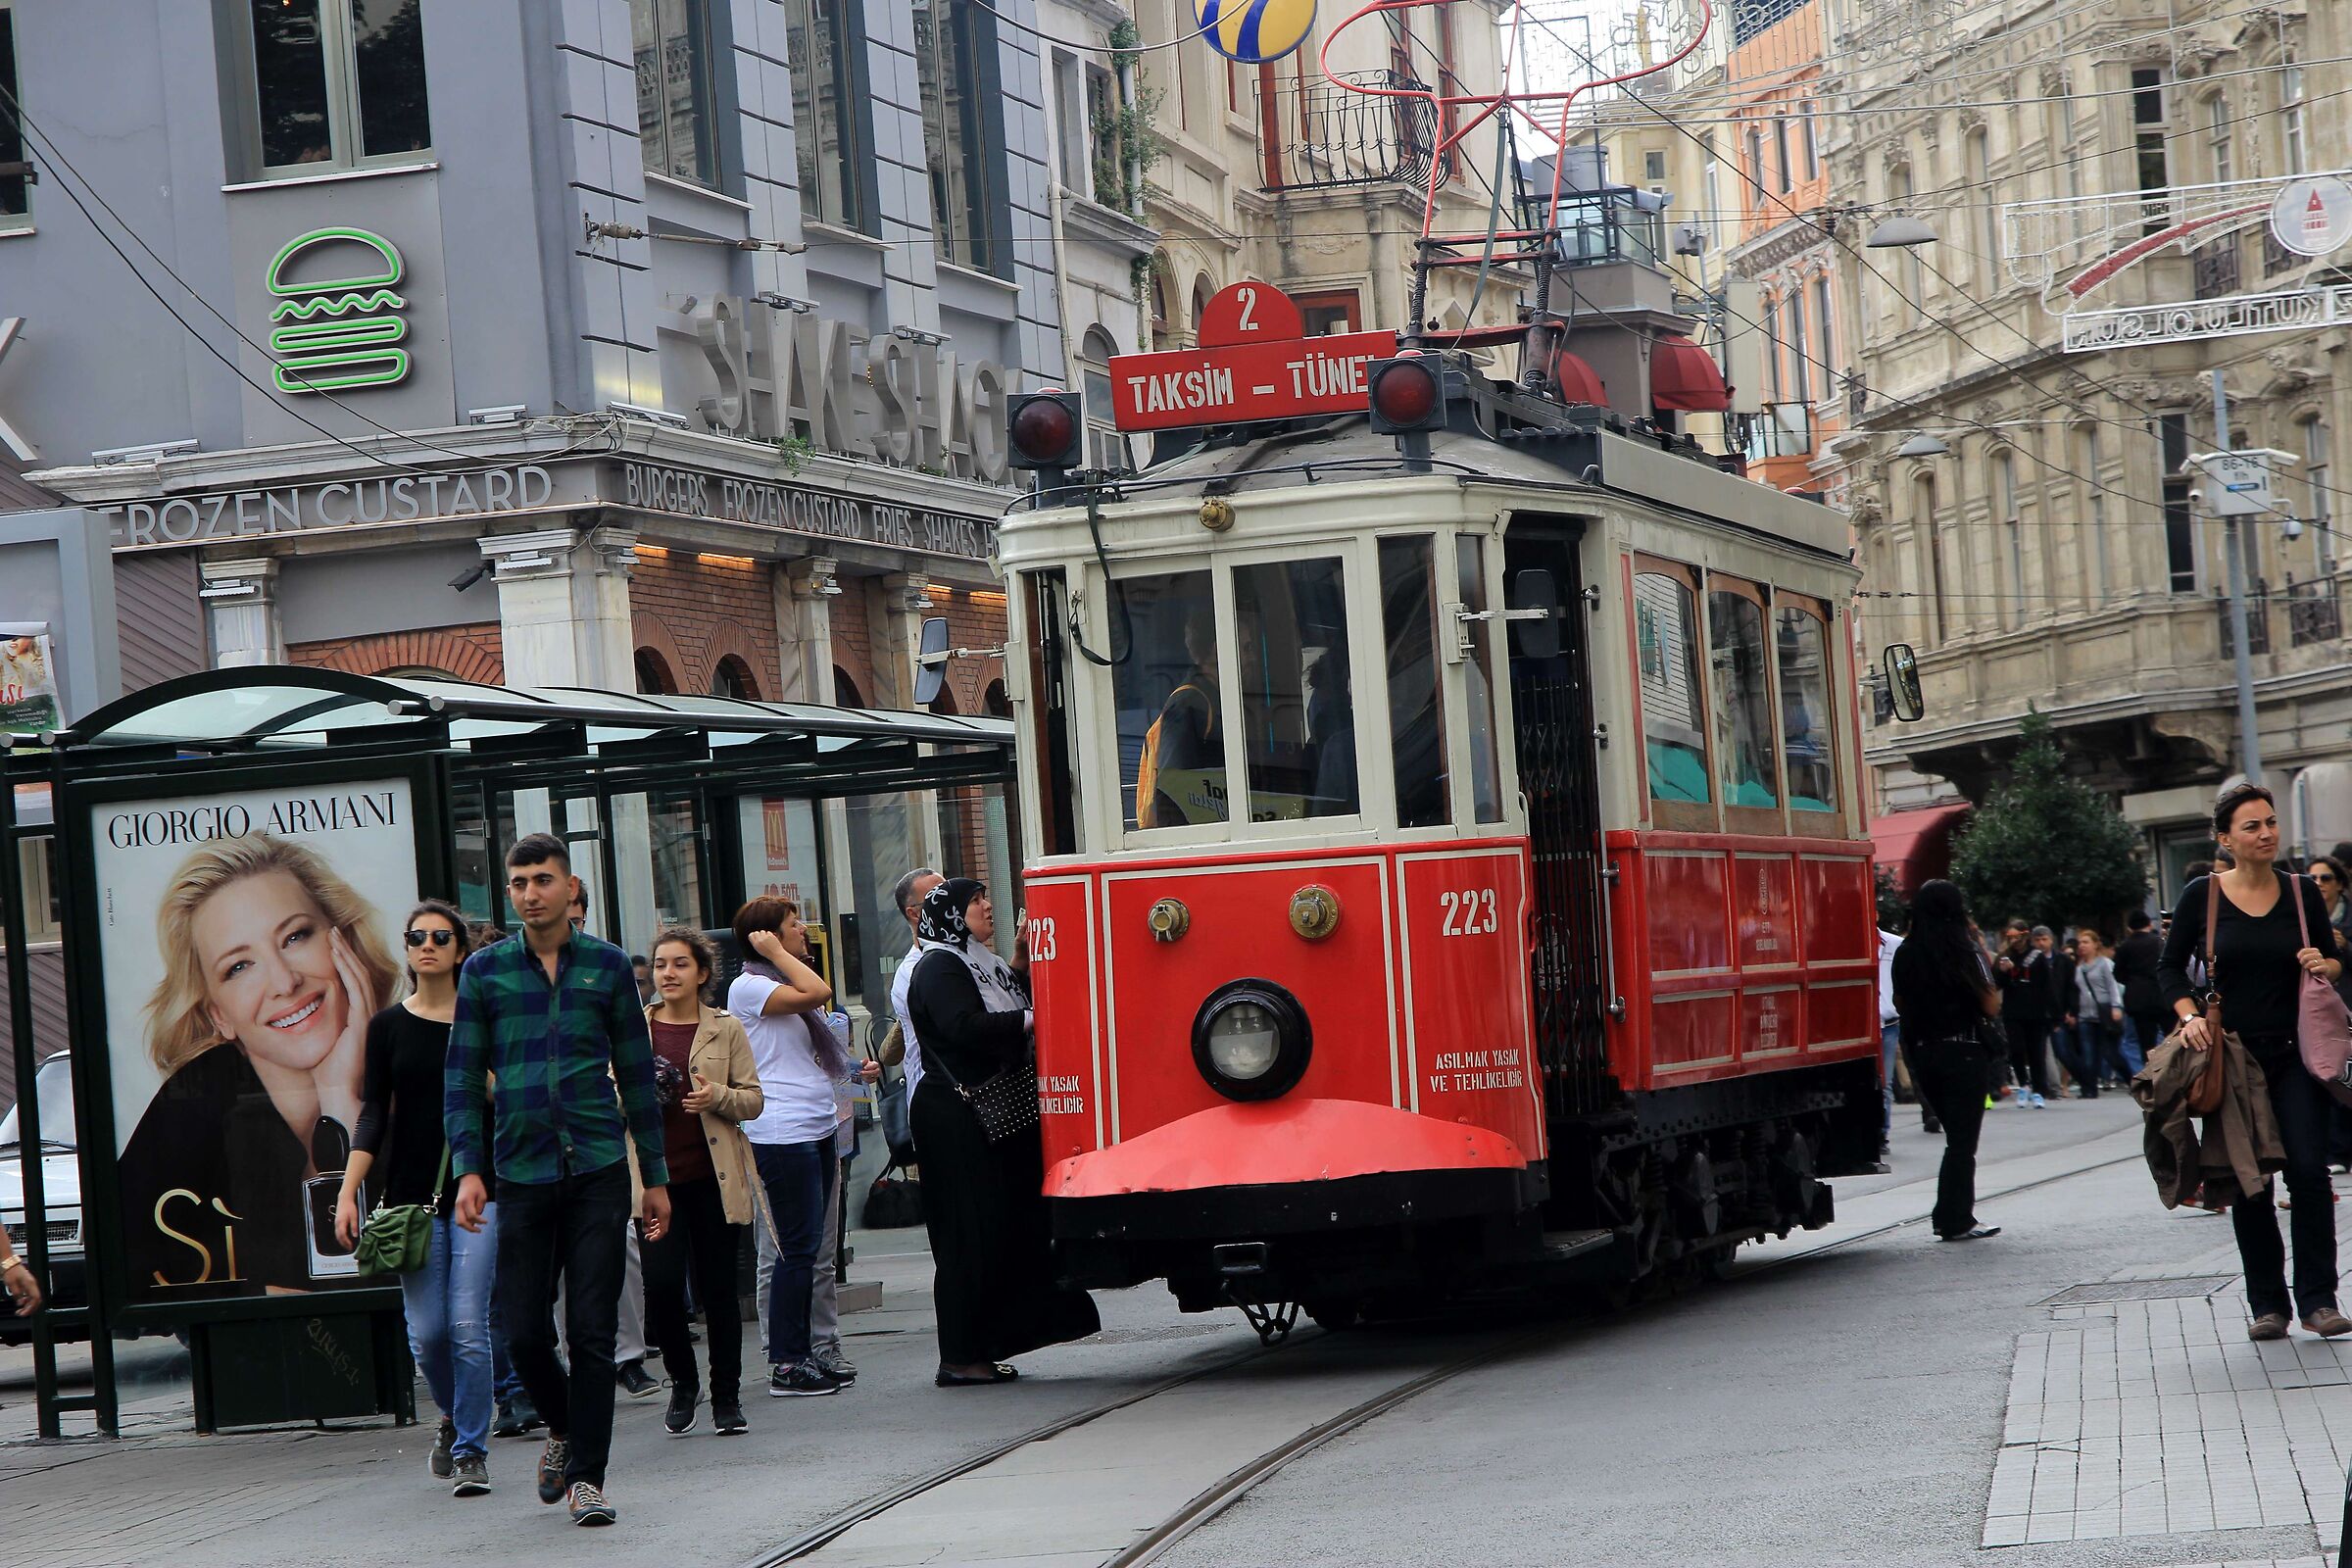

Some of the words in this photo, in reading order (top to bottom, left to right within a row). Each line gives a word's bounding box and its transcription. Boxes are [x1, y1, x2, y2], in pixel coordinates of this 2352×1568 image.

[1237, 287, 1259, 331] 2
[697, 293, 870, 459] SHAKE
[1127, 362, 1235, 414] TAKSİM
[1286, 352, 1375, 399] TÜNE
[316, 466, 553, 526] CUSTARD
[624, 463, 710, 515] BURGERS
[722, 478, 788, 526] FROZEN
[792, 491, 862, 539] CUSTARD
[871, 505, 914, 548] FRIES
[922, 513, 977, 559] SHAKES
[108, 804, 251, 850] GIORGIO
[264, 792, 397, 836] ARMANI
[1440, 888, 1498, 937] 223
[1050, 1075, 1080, 1093] YASAK
[1430, 1074, 1448, 1093] VE
[1453, 1068, 1523, 1092] TEHLİKELİDİR
[1435, 1050, 1489, 1070] ASILMAK
[1492, 1048, 1520, 1067] YASAK
[151, 1187, 247, 1287] Sì
